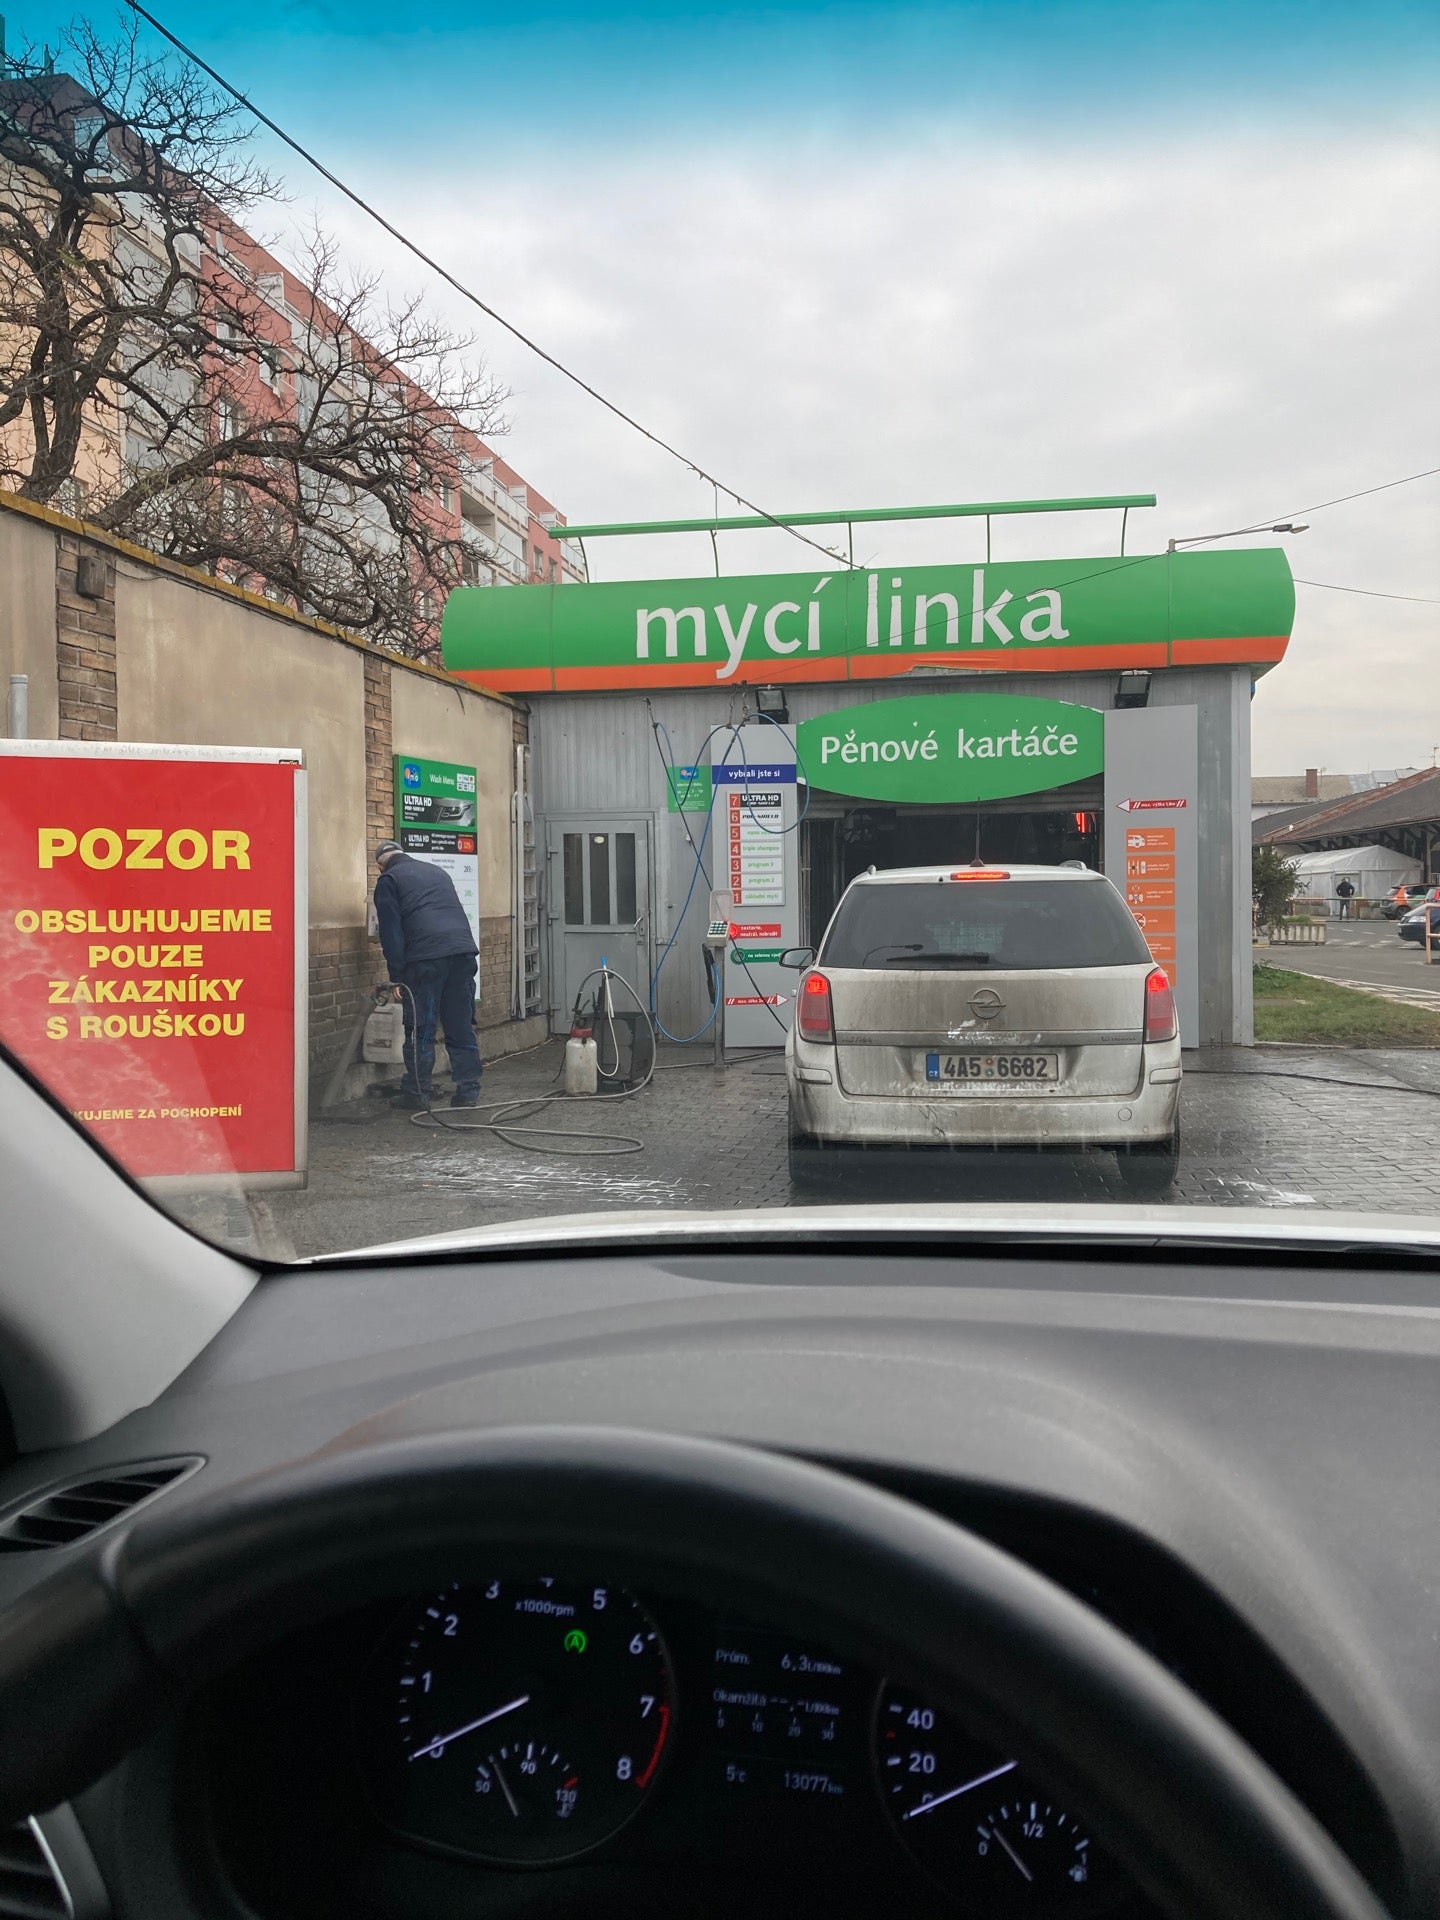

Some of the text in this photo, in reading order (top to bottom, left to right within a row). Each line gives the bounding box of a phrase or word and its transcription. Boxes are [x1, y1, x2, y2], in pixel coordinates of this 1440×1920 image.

[636, 569, 1070, 679] mycí linka
[821, 725, 1078, 764] Pěnové kartáče
[757, 770, 772, 779] jste
[773, 769, 780, 777] si
[404, 795, 433, 808] ULTRA HD
[731, 796, 738, 806] 7
[731, 813, 739, 823] 6
[731, 829, 738, 839] 5
[38, 828, 251, 871] POZOR
[732, 845, 739, 854] 4
[732, 860, 740, 870] 3
[733, 876, 740, 887] 2
[734, 893, 740, 902] 1
[14, 909, 272, 933] OBSLUHUJEME
[88, 945, 203, 968] POUZE
[48, 974, 244, 1004] ZÁKAZNÍKY
[46, 1009, 245, 1040] S ROUŠKOU
[944, 1057, 1048, 1078] 4A5 6682
[72, 1104, 242, 1121] KUJEME ZA POCHOPENÍ
[514, 1599, 575, 1617] x1000rpm
[592, 1588, 607, 1610] 5
[443, 1614, 459, 1636] 2
[629, 1633, 644, 1654] 6
[421, 1671, 433, 1693] 1
[640, 1694, 655, 1719] 7
[907, 1708, 935, 1730] 40
[520, 1761, 536, 1775] 90
[616, 1755, 632, 1780] 8
[908, 1752, 937, 1774] 20
[475, 1779, 490, 1794] 50
[555, 1788, 577, 1803] 130
[1023, 1821, 1045, 1839] 1/2
[978, 1841, 989, 1856] 0
